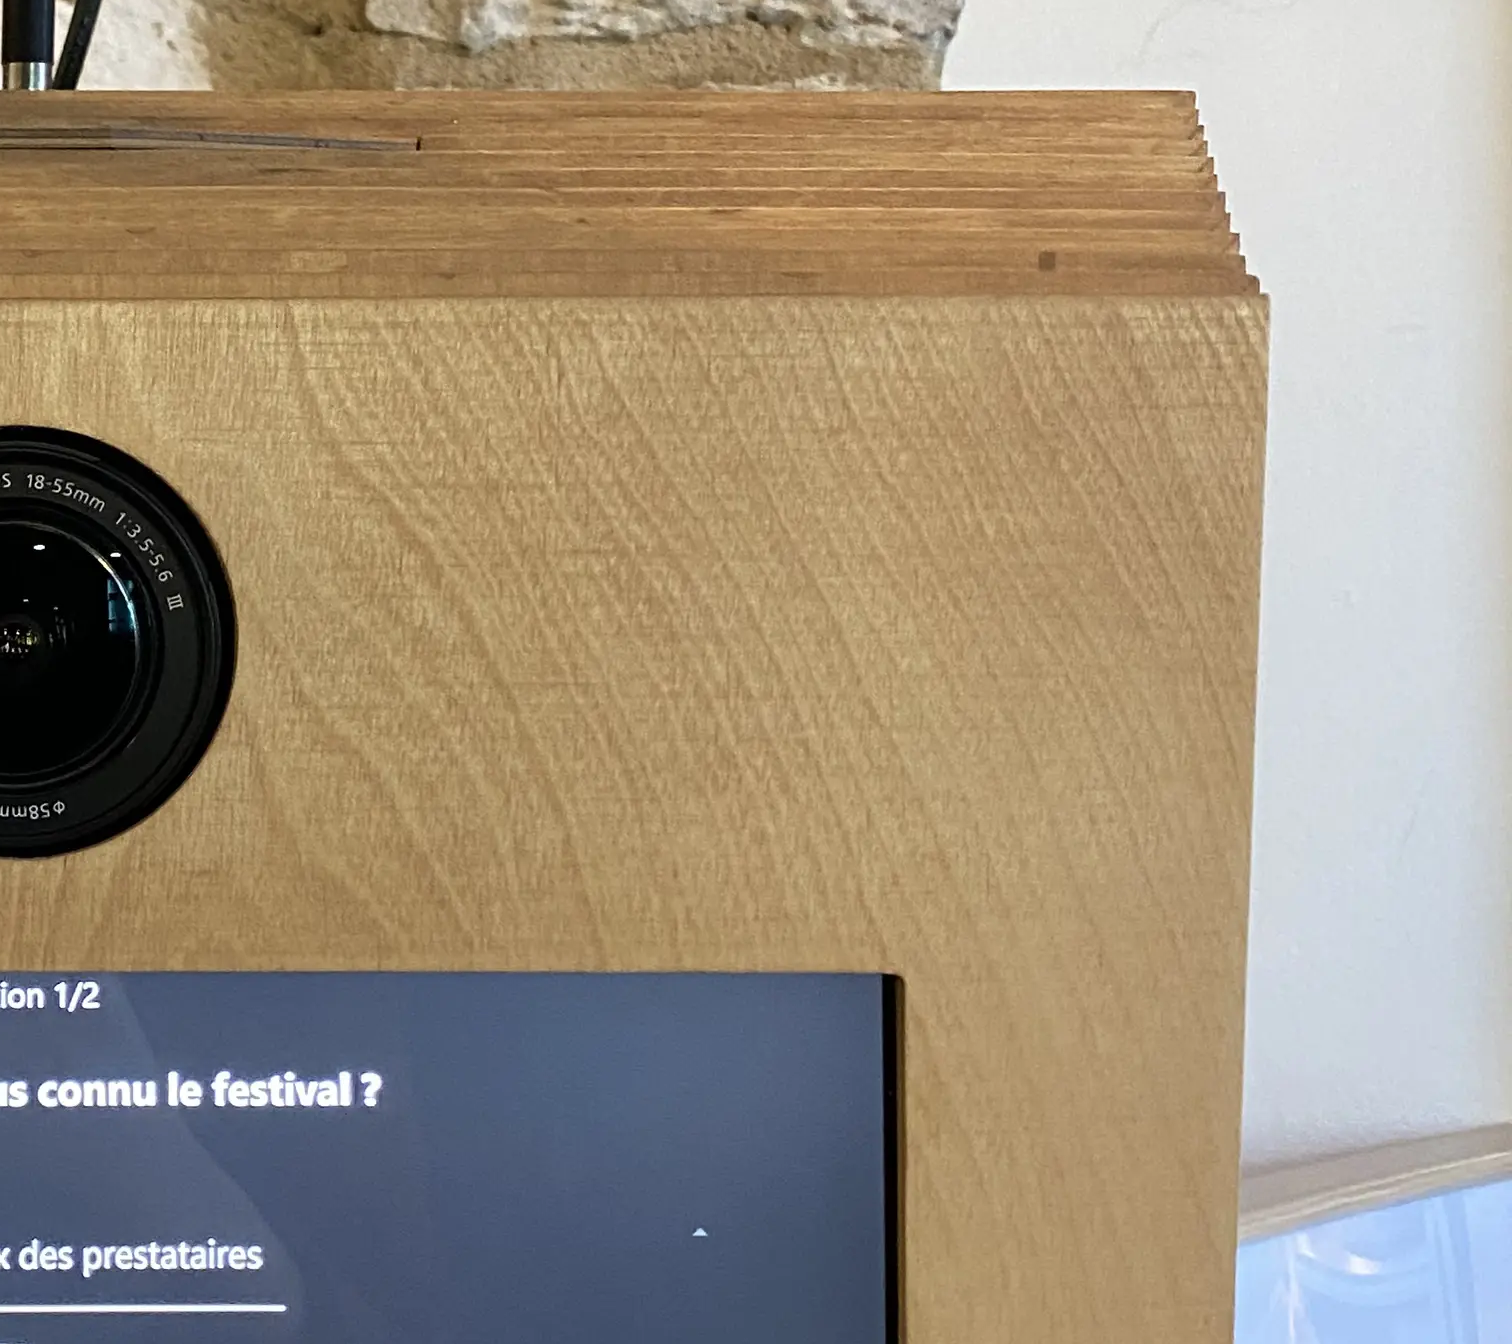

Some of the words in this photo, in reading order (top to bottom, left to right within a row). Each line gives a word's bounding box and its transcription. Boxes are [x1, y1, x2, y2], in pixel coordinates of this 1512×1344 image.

[26, 473, 106, 513] 18-55mm
[115, 511, 174, 583] 1:3.5-5.6
[54, 981, 101, 1013] 1/2
[37, 1078, 158, 1109] connu
[167, 1071, 203, 1108] le
[210, 1071, 353, 1108] festival
[359, 1071, 383, 1108] ?
[17, 1238, 75, 1271] des
[82, 1237, 264, 1278] prestataires
